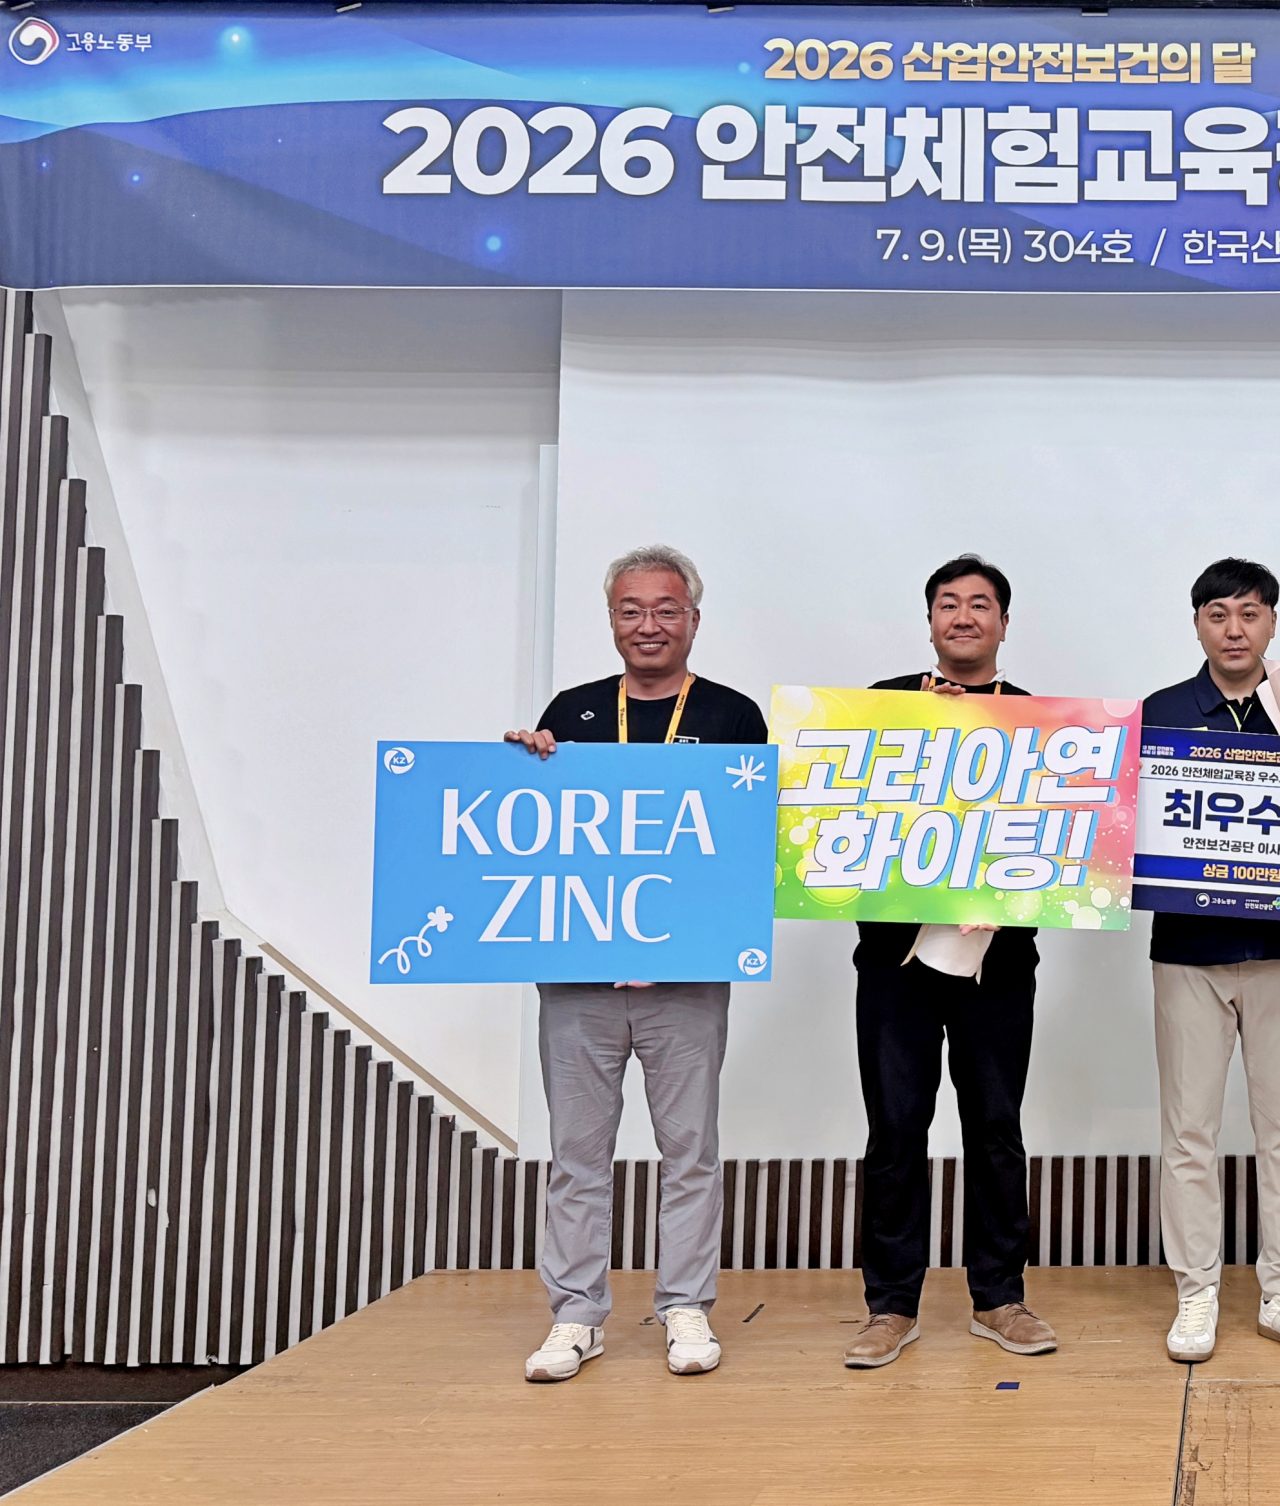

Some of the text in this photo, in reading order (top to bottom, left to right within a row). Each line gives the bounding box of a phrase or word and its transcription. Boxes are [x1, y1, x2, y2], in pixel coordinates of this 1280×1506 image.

[66, 31, 152, 52] 고용노동부
[764, 38, 1256, 84] 2026 산업안전보건의 달
[382, 106, 675, 196] 2026
[876, 229, 909, 262] 7.
[919, 227, 1012, 264] 9.(목)
[1023, 229, 1134, 264] 304호
[392, 756, 406, 765] KZ
[777, 725, 1127, 806] 고려아연
[1189, 746, 1221, 759] 2026
[1151, 765, 1179, 777] 2026
[1182, 766, 1256, 782] 안전체험교육장
[442, 788, 716, 855] KOREA
[803, 809, 1100, 891] 화이팅!
[1183, 836, 1254, 854] 안전보건공단
[1202, 863, 1229, 879] 상금
[478, 873, 673, 943] ZINC
[746, 957, 759, 966] KZ
